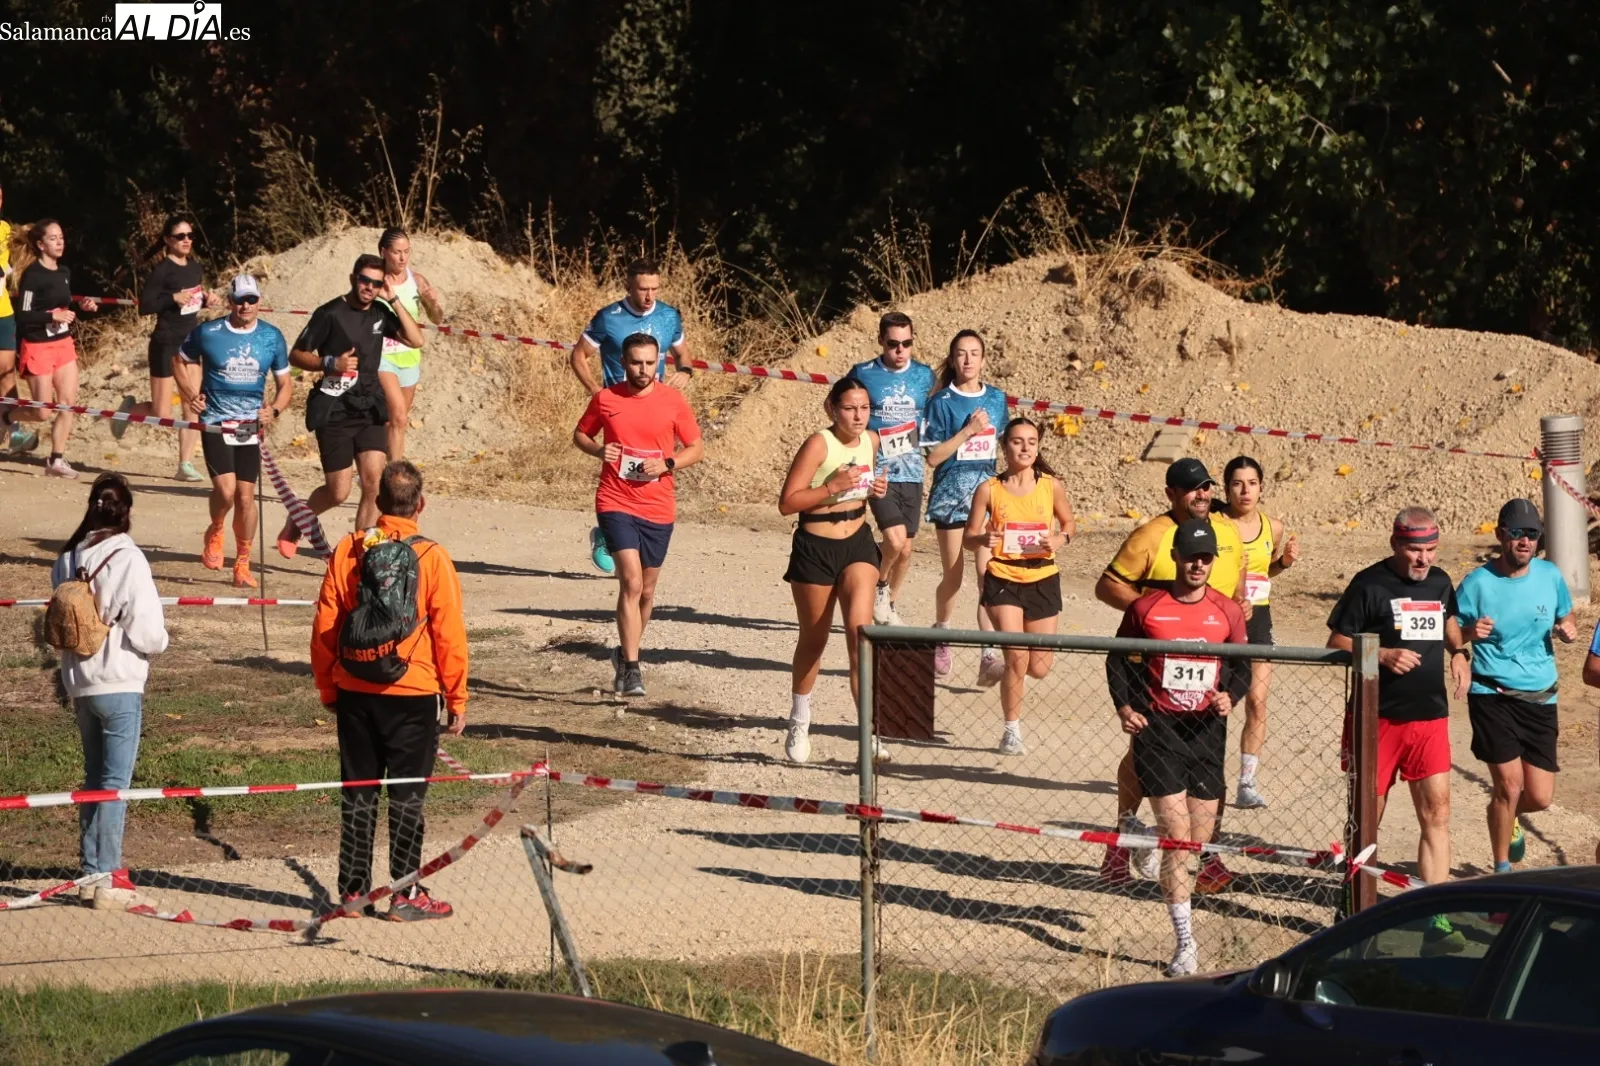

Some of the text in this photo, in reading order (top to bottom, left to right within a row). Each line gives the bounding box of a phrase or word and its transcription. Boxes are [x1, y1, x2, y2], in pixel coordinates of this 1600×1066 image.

[328, 379, 350, 391] 335
[889, 435, 912, 449] 171
[964, 440, 990, 452] 230
[1017, 534, 1036, 547] 92
[1410, 616, 1436, 631] 329
[1173, 666, 1205, 681] 311
